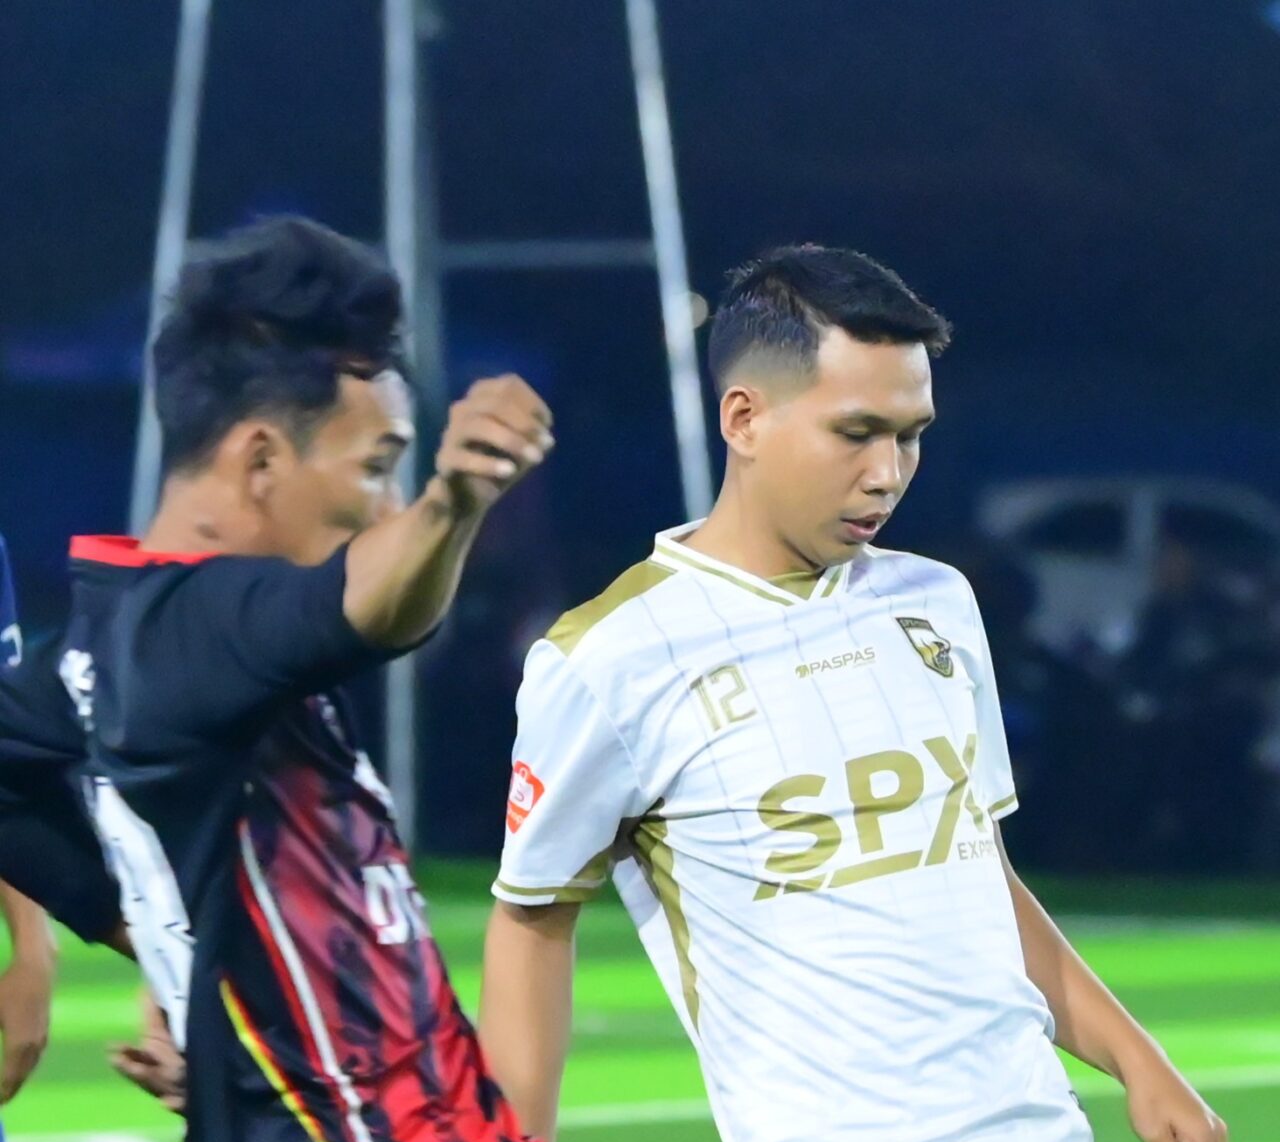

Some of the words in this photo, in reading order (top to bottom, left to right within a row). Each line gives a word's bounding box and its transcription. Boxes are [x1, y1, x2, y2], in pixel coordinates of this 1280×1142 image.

[809, 646, 876, 675] PASPAS
[690, 664, 758, 732] 12
[757, 733, 987, 874] SPX
